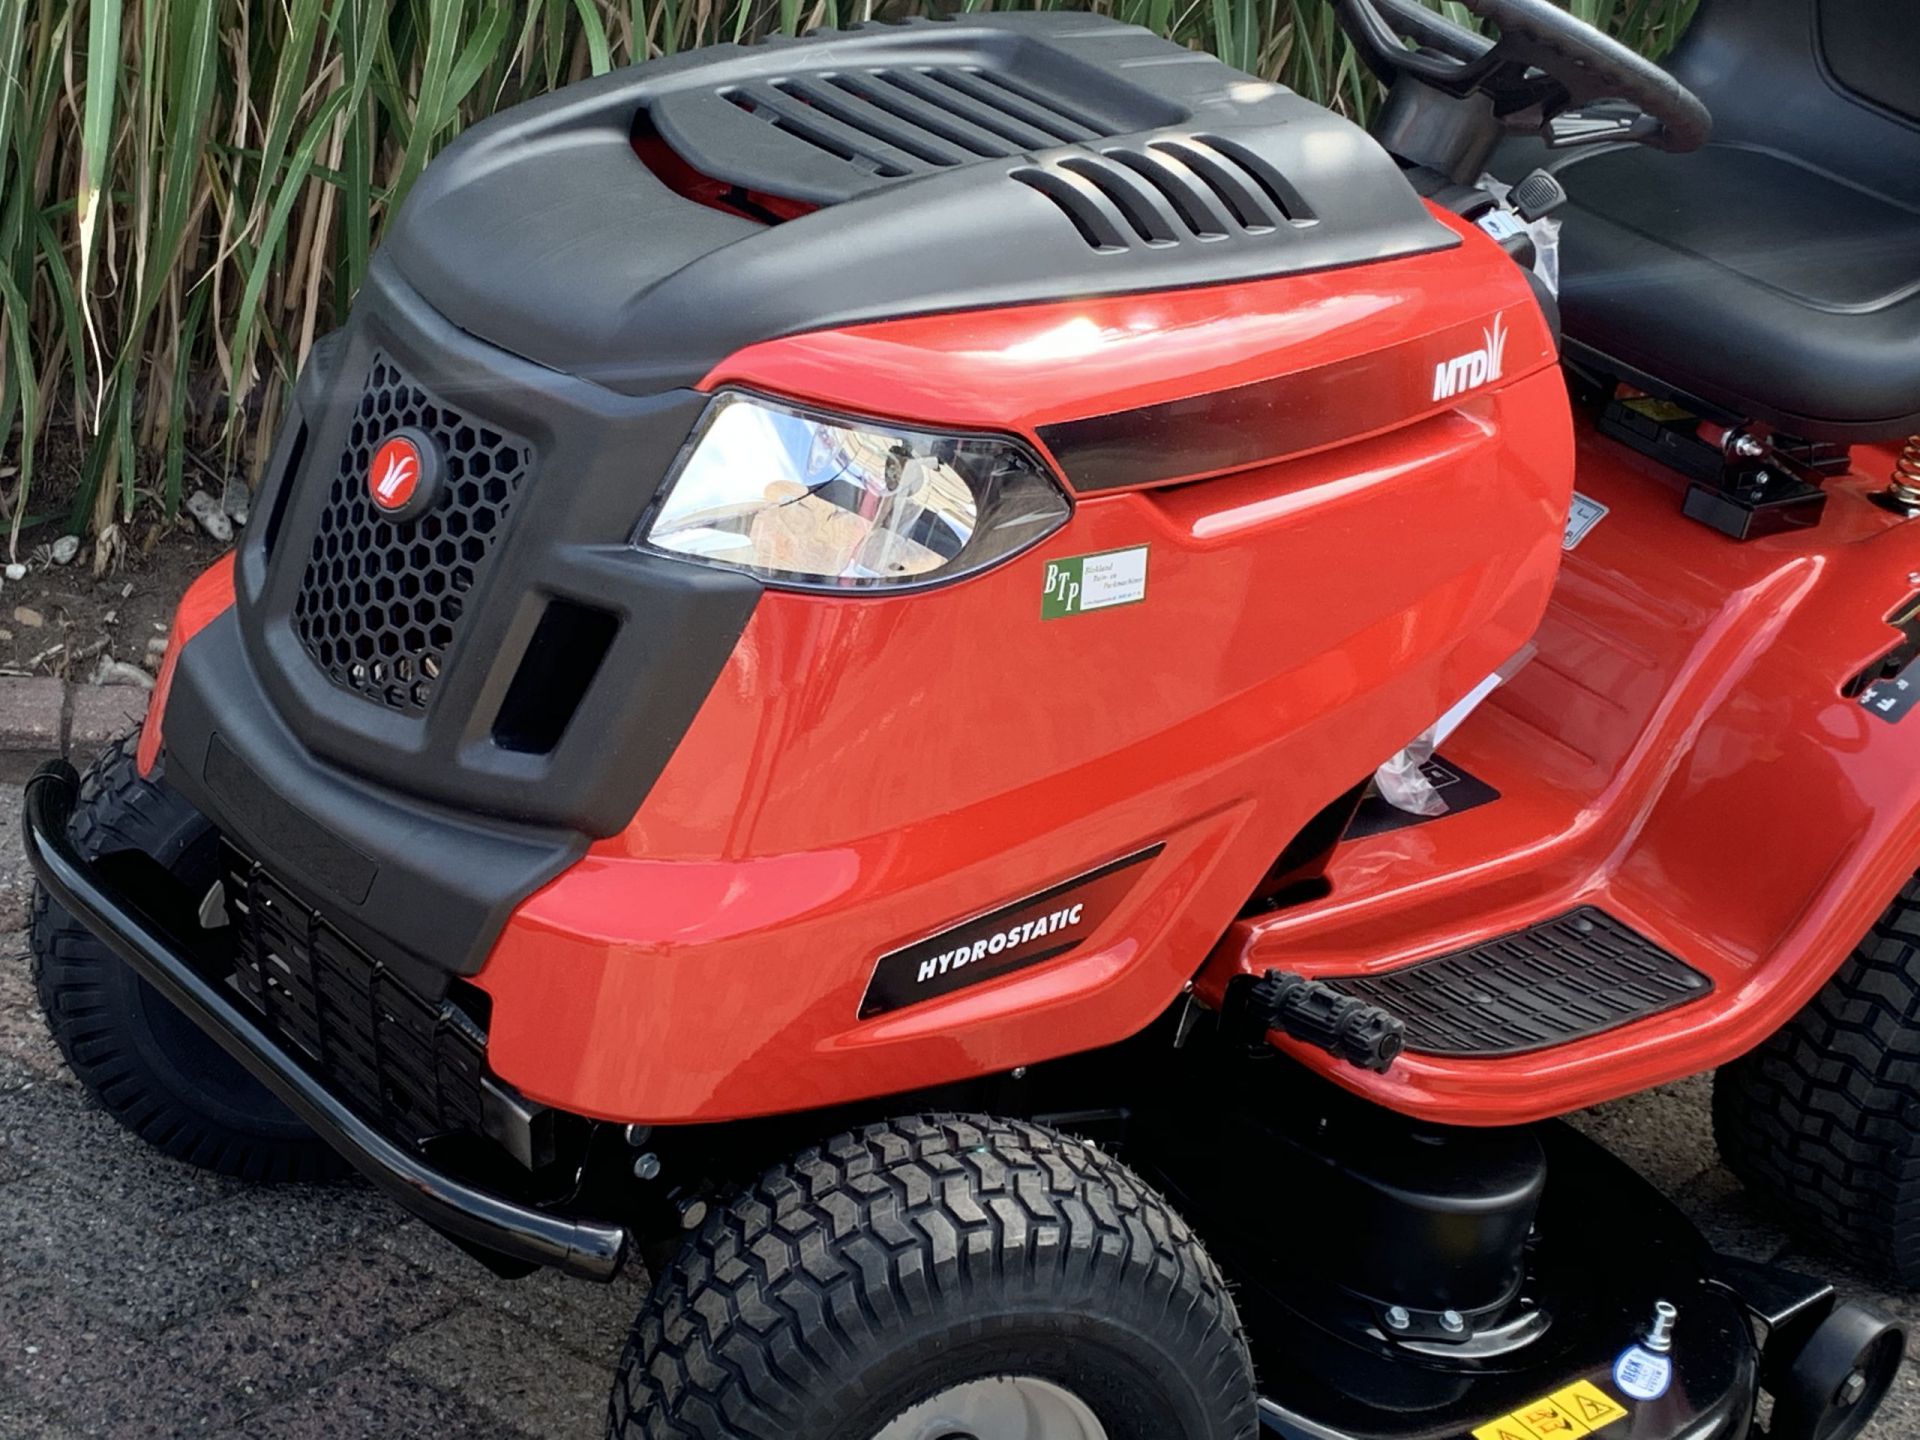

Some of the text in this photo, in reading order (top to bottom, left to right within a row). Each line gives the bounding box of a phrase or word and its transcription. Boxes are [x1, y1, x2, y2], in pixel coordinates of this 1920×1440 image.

[1432, 349, 1488, 402] MTD
[1043, 564, 1080, 611] BTP
[916, 903, 1084, 983] HYDROSTATIC
